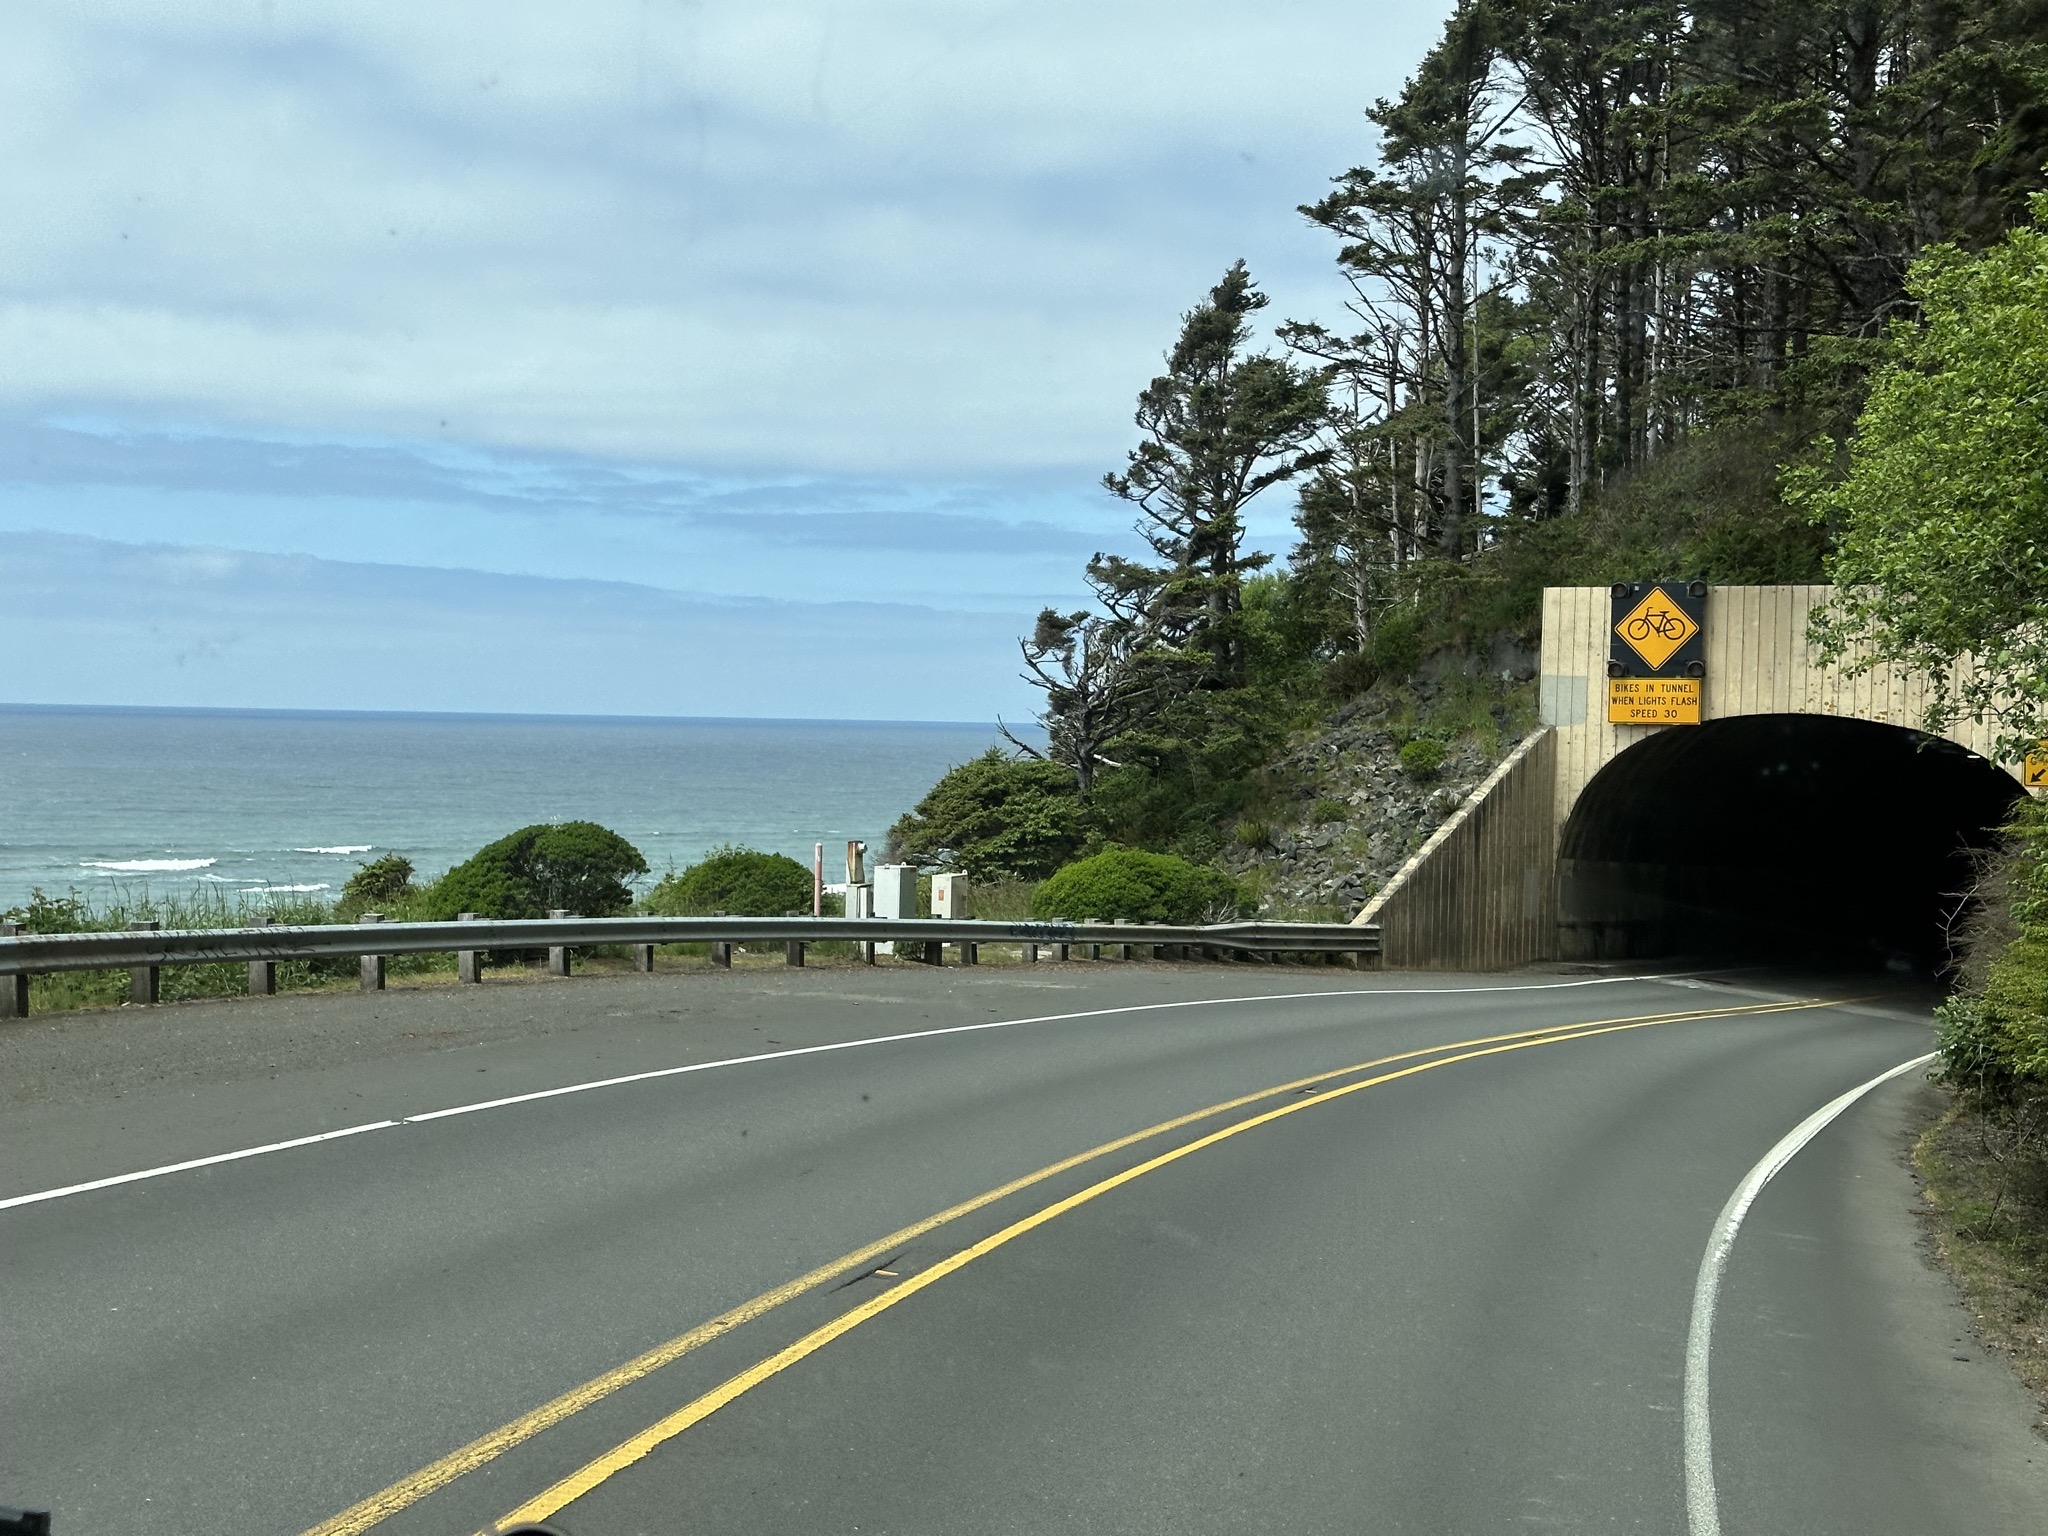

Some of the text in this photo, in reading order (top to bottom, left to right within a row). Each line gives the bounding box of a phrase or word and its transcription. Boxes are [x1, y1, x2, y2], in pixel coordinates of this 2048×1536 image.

[1615, 684, 1694, 693] BIKES IN TUNNEL
[1612, 696, 1697, 705] WHEN LIGHTS FLASH
[1630, 709, 1678, 718] SPEED 30
